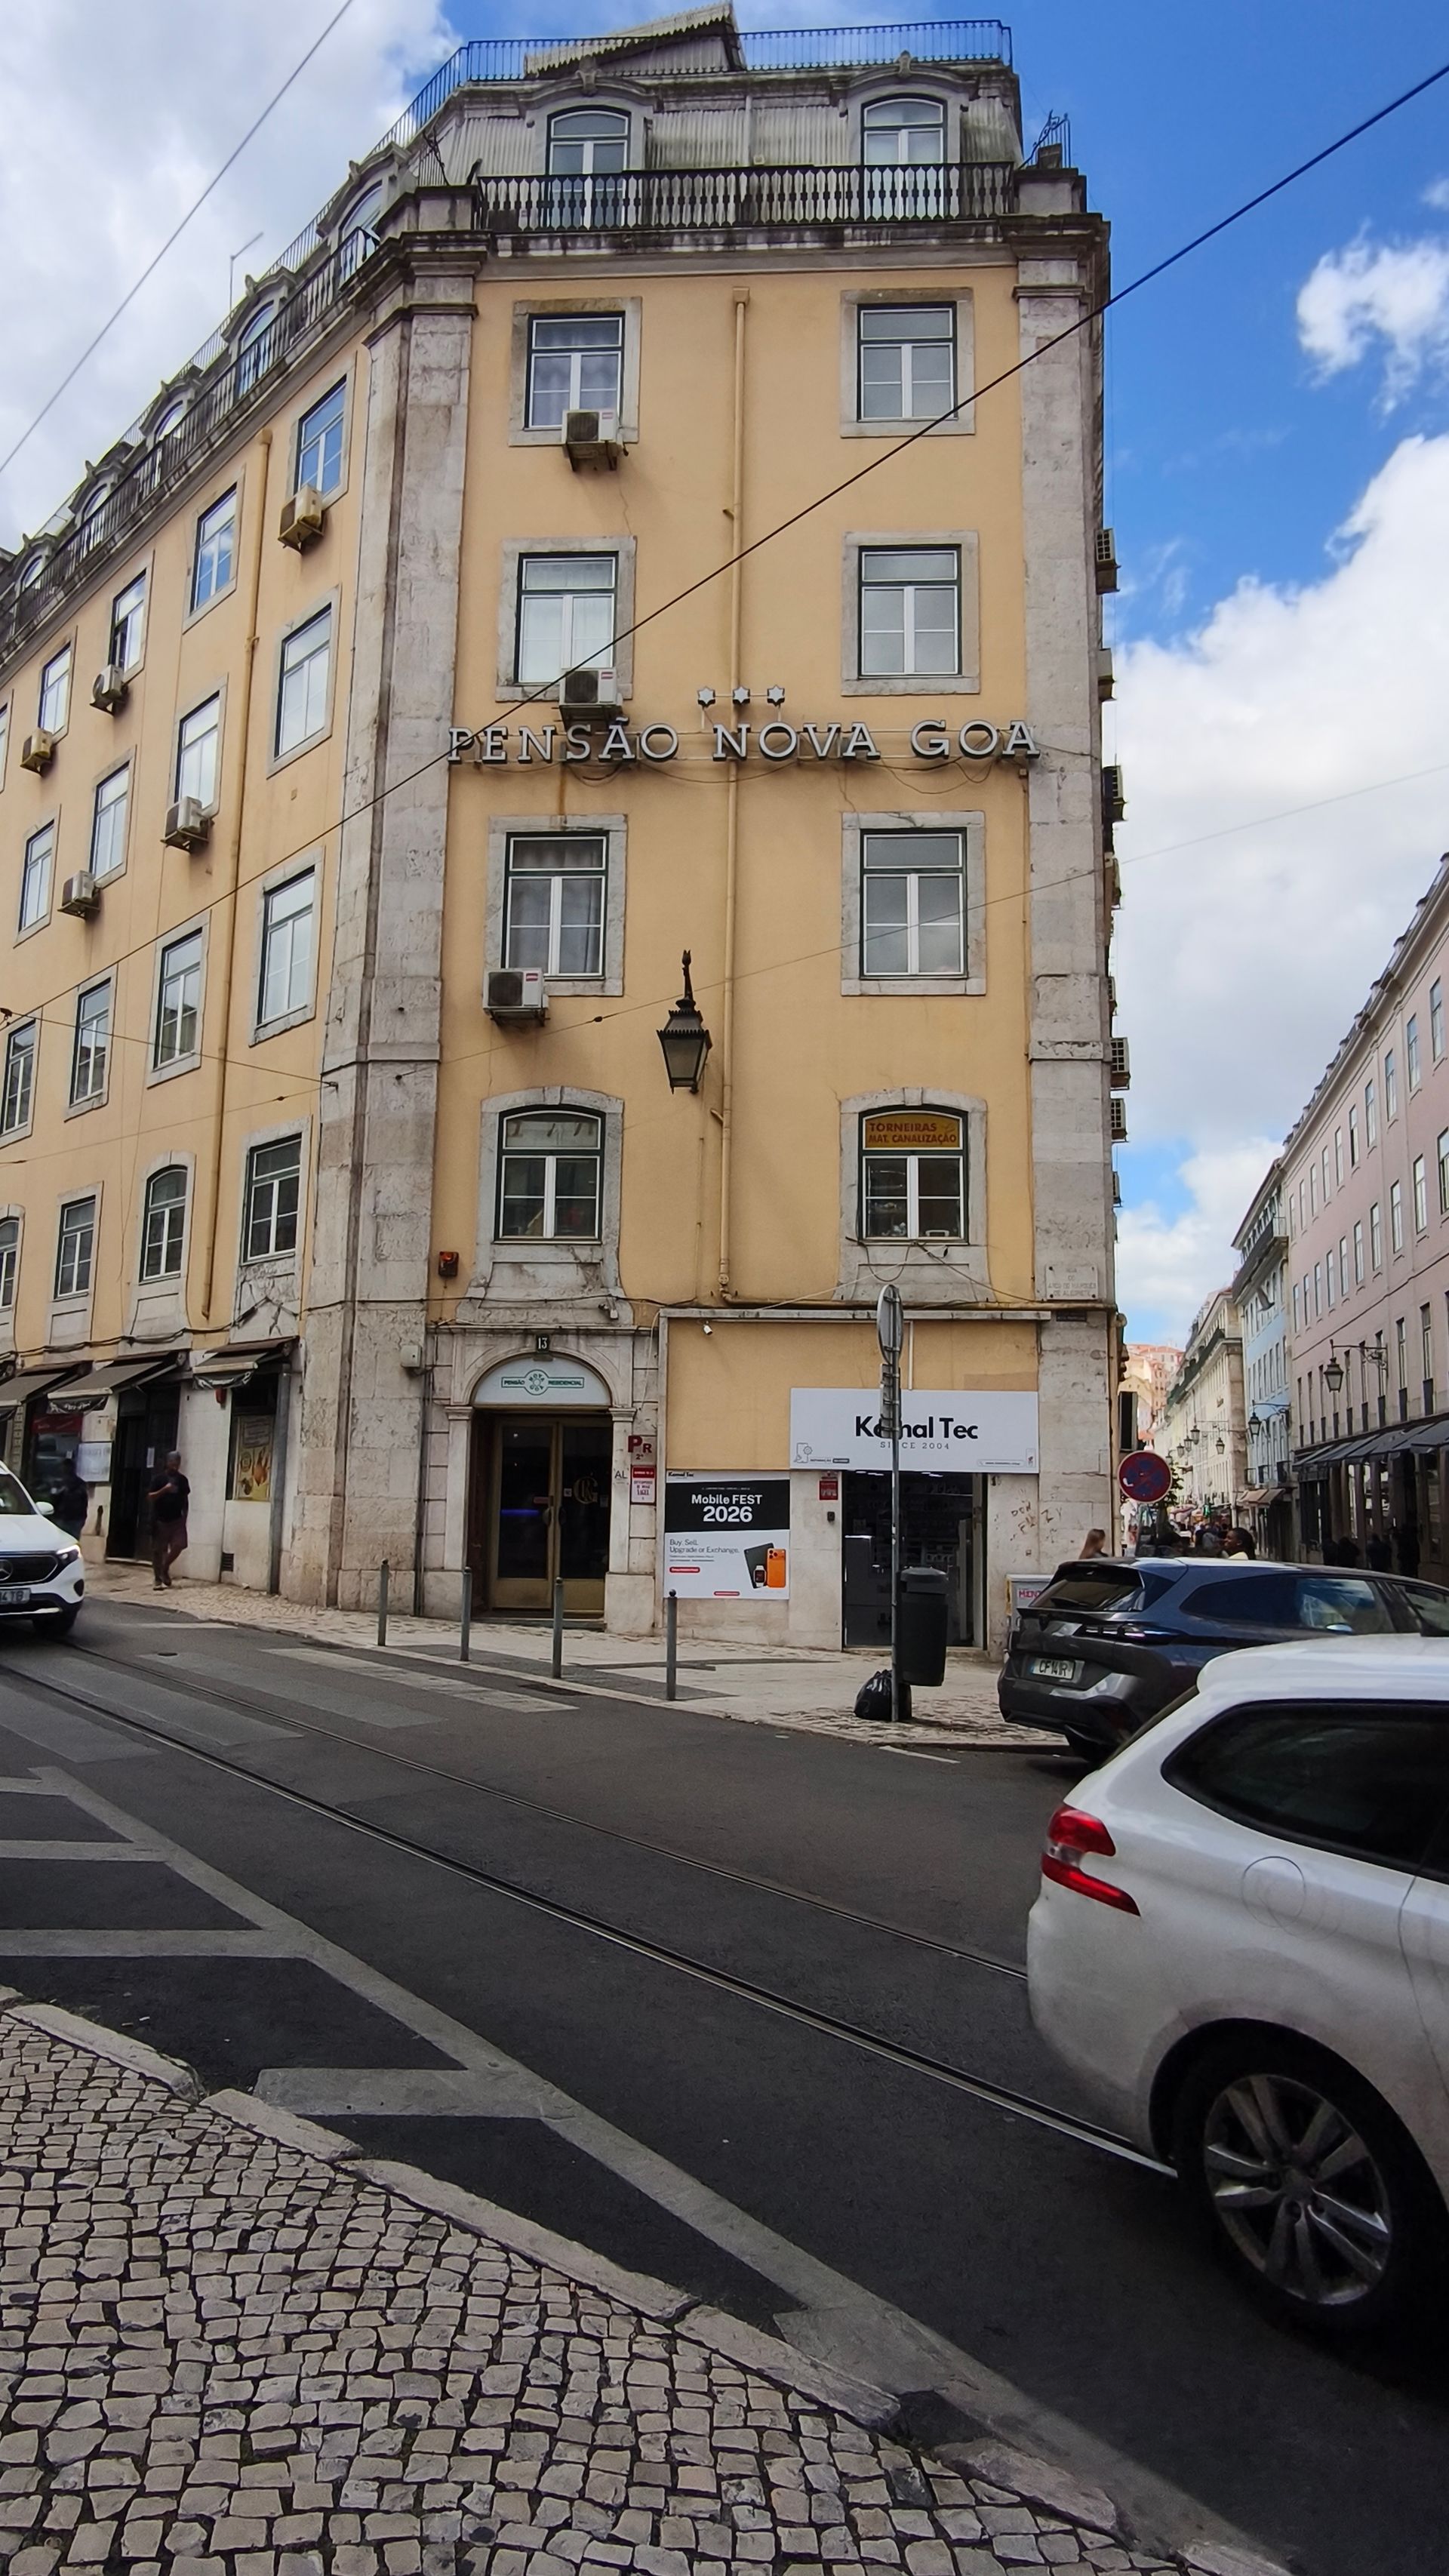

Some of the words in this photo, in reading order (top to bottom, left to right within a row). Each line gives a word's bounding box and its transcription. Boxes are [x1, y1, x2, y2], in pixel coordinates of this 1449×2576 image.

[448, 717, 679, 763] PENSÃO
[712, 721, 881, 761] NOVA
[911, 719, 1041, 759] GOA
[869, 1123, 937, 1132] TORNEIRAS
[892, 1134, 957, 1145] CANALIZAÇÃO
[538, 1337, 548, 1350] 13
[939, 1417, 978, 1439] Tec
[614, 1470, 628, 1479] AL
[691, 1494, 730, 1504] Mobile
[732, 1494, 762, 1504] FEST
[703, 1506, 753, 1522] 2026
